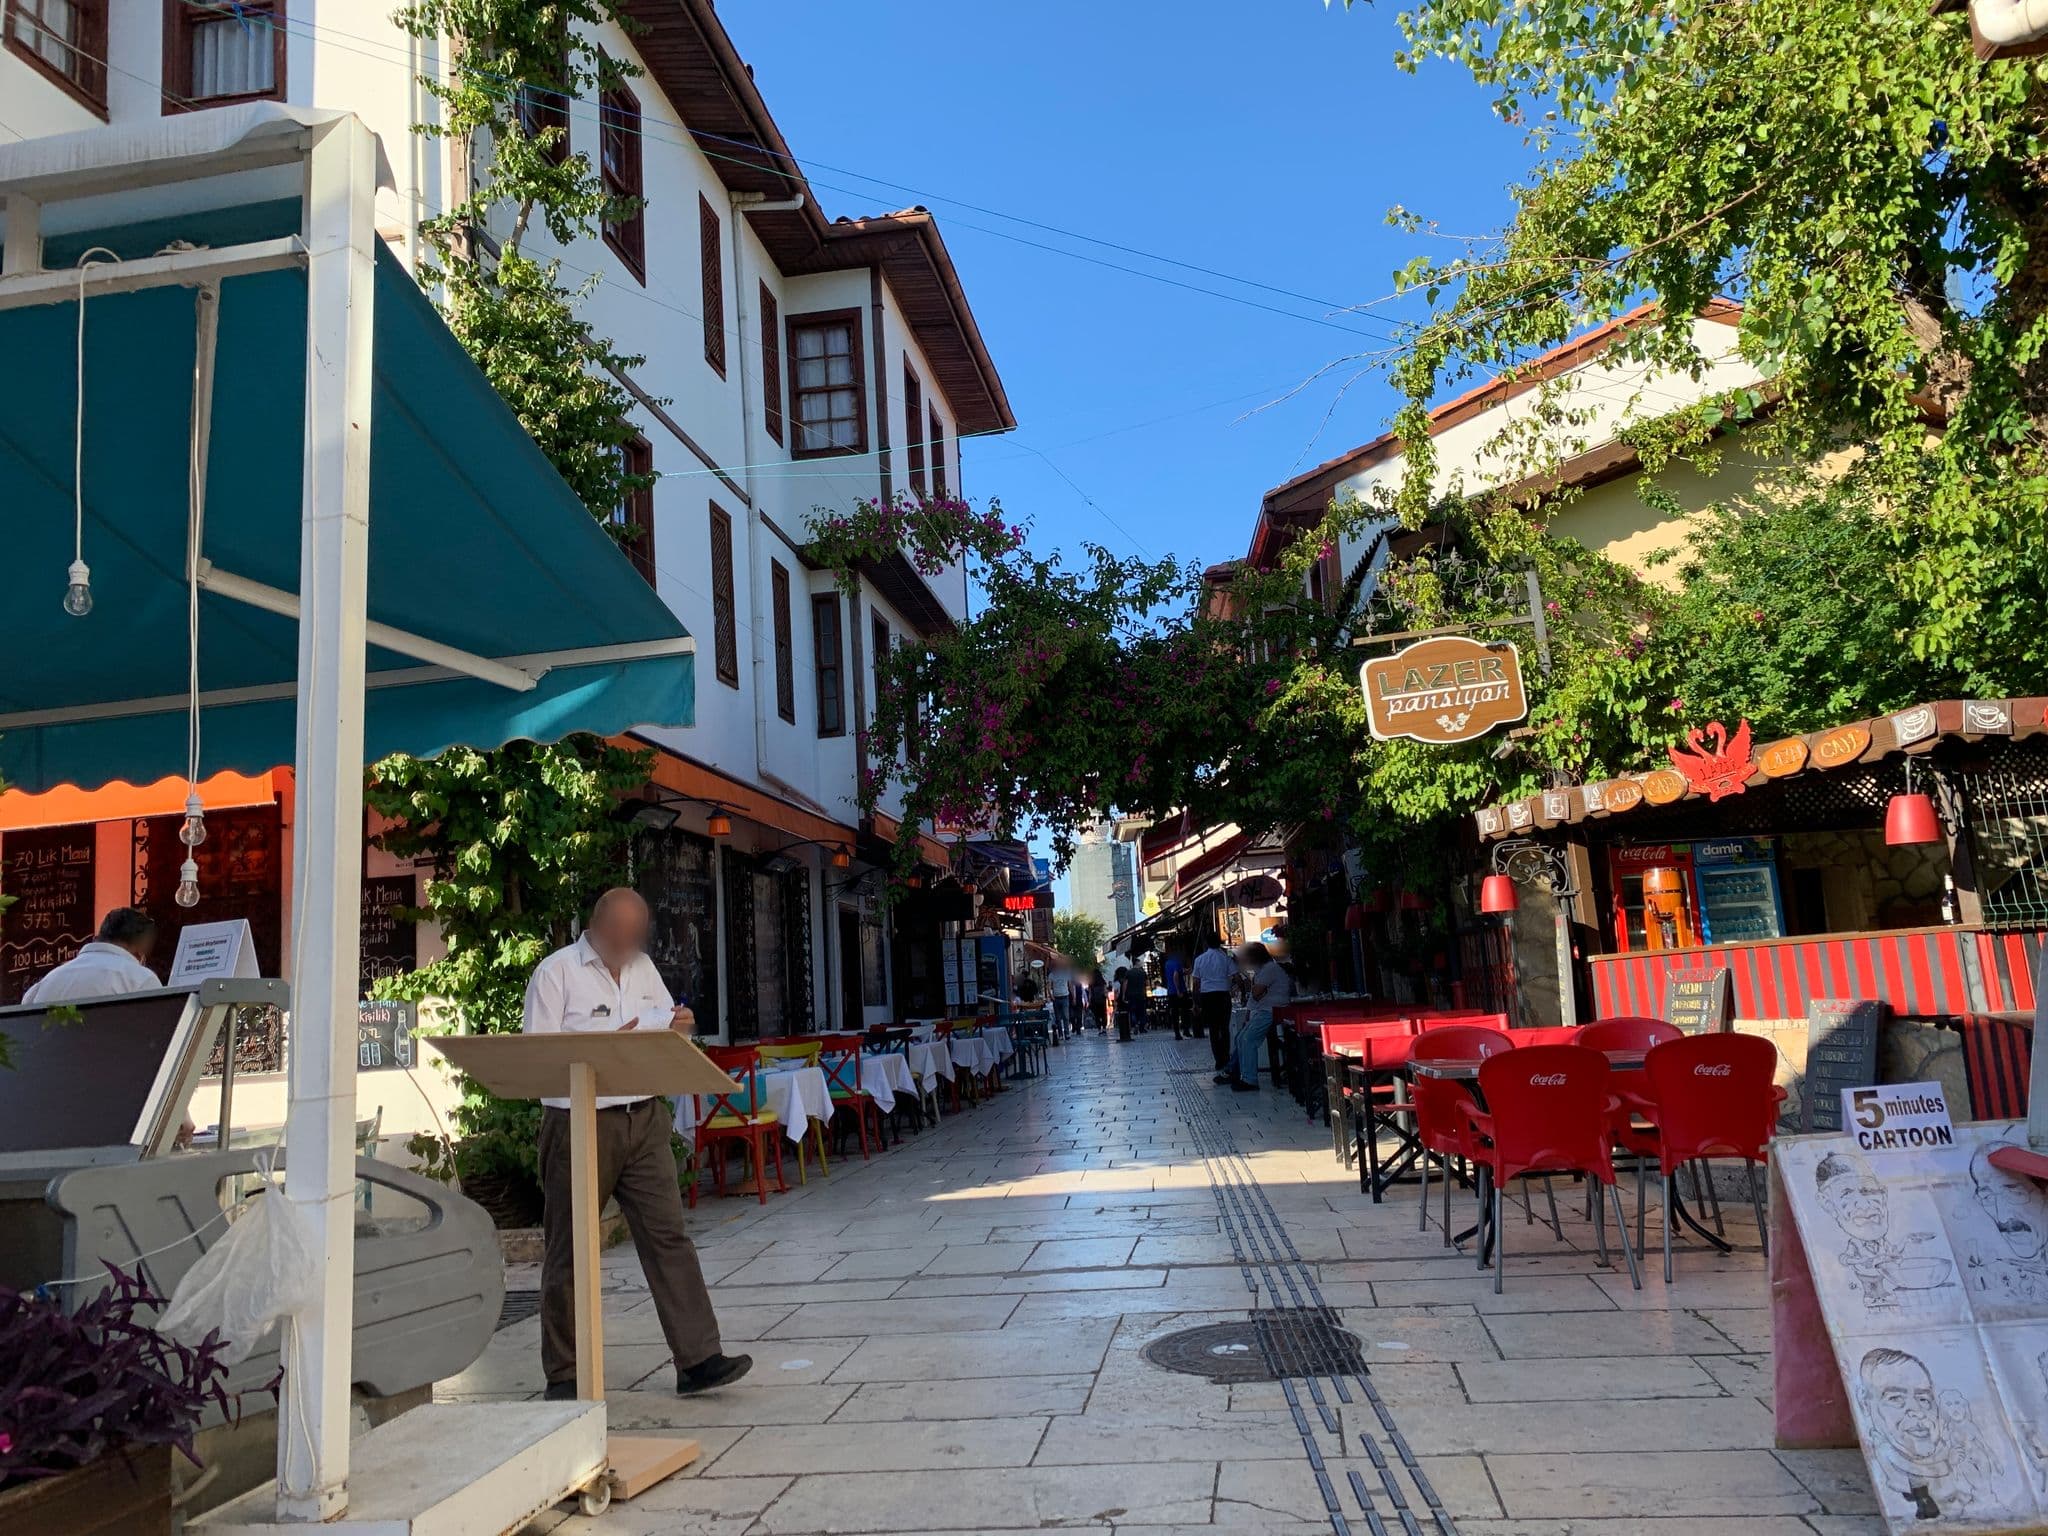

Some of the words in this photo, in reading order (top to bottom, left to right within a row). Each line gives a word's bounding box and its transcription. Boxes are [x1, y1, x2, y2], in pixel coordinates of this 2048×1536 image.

[1377, 656, 1508, 696] LAZER
[1702, 843, 1743, 856] damla
[15, 850, 34, 867] 70
[12, 953, 32, 968] 100
[1694, 1063, 1732, 1077] Coca-Cola
[1530, 1073, 1567, 1086] Coca-Cola
[1853, 1089, 1885, 1129] 5
[1884, 1094, 1945, 1117] minutes
[1858, 1125, 1953, 1151] CARTOON
